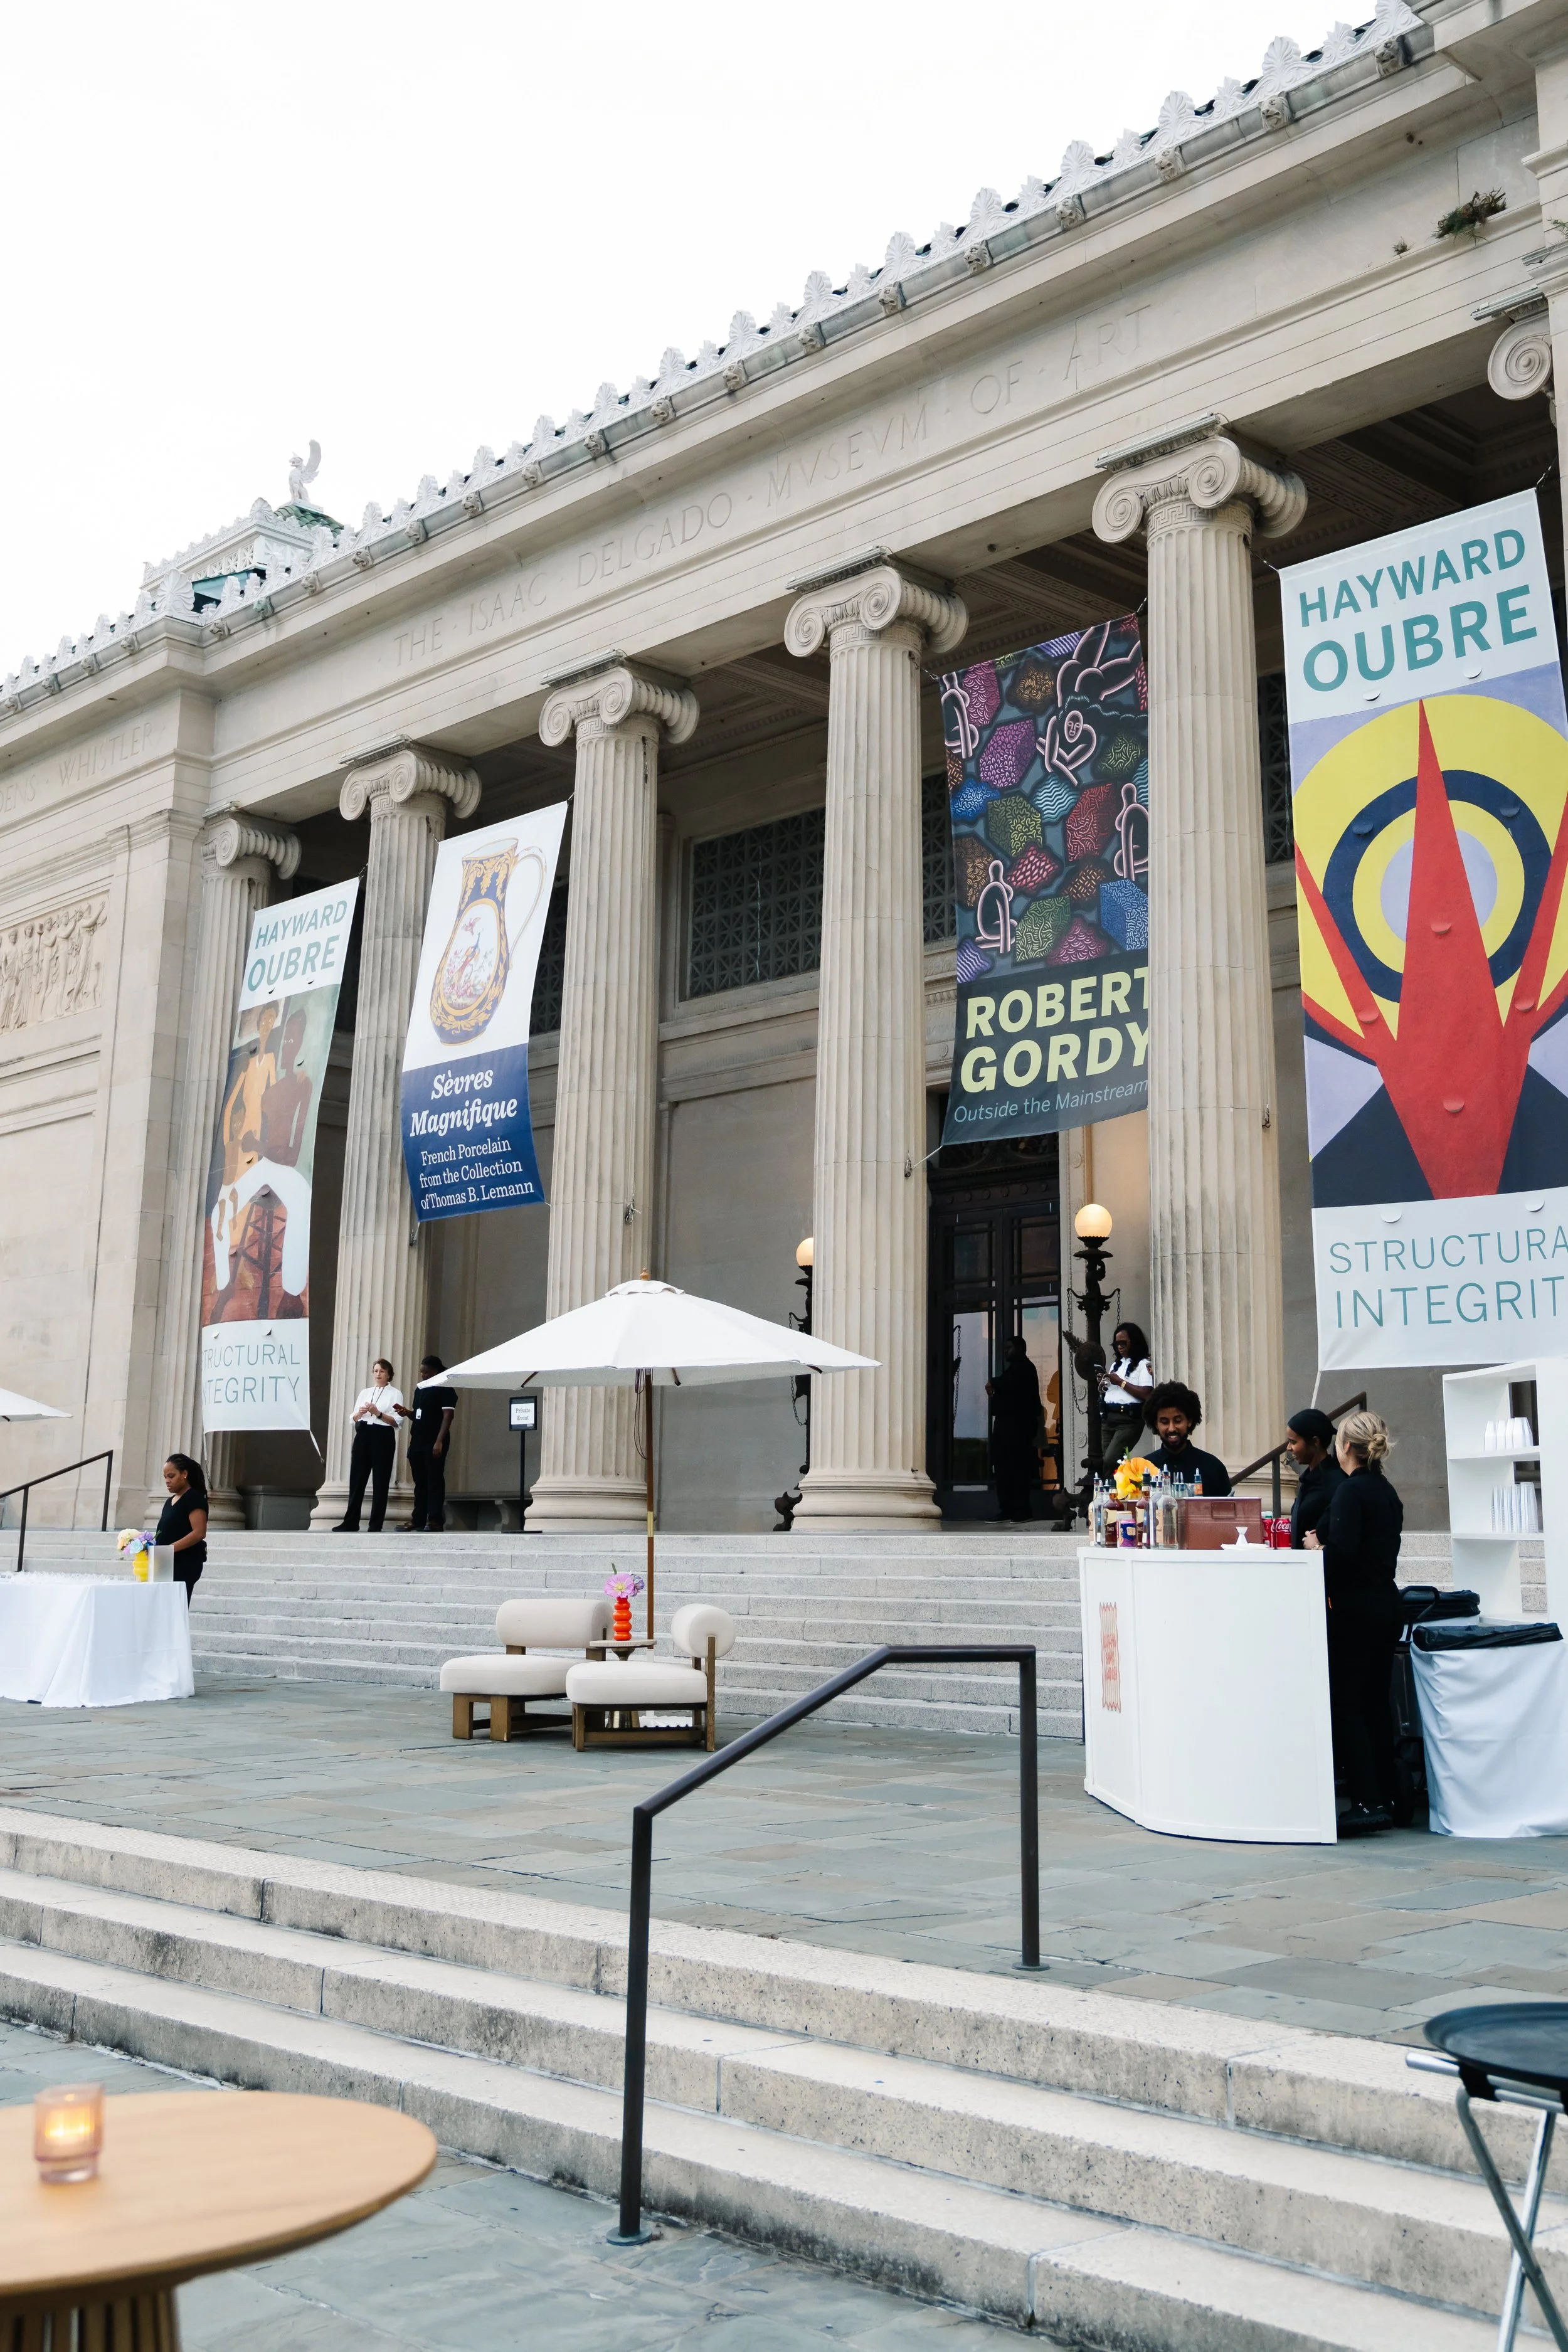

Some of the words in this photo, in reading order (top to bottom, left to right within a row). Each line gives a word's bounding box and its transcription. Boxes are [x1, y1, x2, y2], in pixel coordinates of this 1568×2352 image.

[393, 617, 443, 667] THE
[467, 572, 548, 637] ISAAC
[576, 492, 733, 589] DELGADO
[765, 402, 928, 507] MVSEVM
[970, 361, 1022, 415] OF
[1062, 304, 1152, 382] ART
[1299, 529, 1525, 628] HAYWARD
[1303, 584, 1537, 692] OUBRE
[59, 723, 152, 787] WHISTLER
[255, 900, 347, 950] HAYWARD
[248, 935, 340, 992] OUBRE
[966, 967, 1148, 1039] ROBERT
[960, 1022, 1148, 1093] GORDY
[431, 1069, 494, 1100] Sèvres
[954, 1101, 1018, 1123] Outside
[1024, 1098, 1051, 1115] the
[1056, 1079, 1148, 1111] Mainstream
[410, 1098, 517, 1136] Magnifique
[420, 1172, 442, 1189] from
[442, 1168, 459, 1183] the
[460, 1159, 523, 1181] Collection
[421, 1145, 457, 1166] French
[457, 1137, 511, 1158] Porcelain
[420, 1194, 430, 1210] of
[428, 1192, 466, 1208] Thomas
[467, 1187, 479, 1202] B.
[480, 1181, 534, 1200] Lemann
